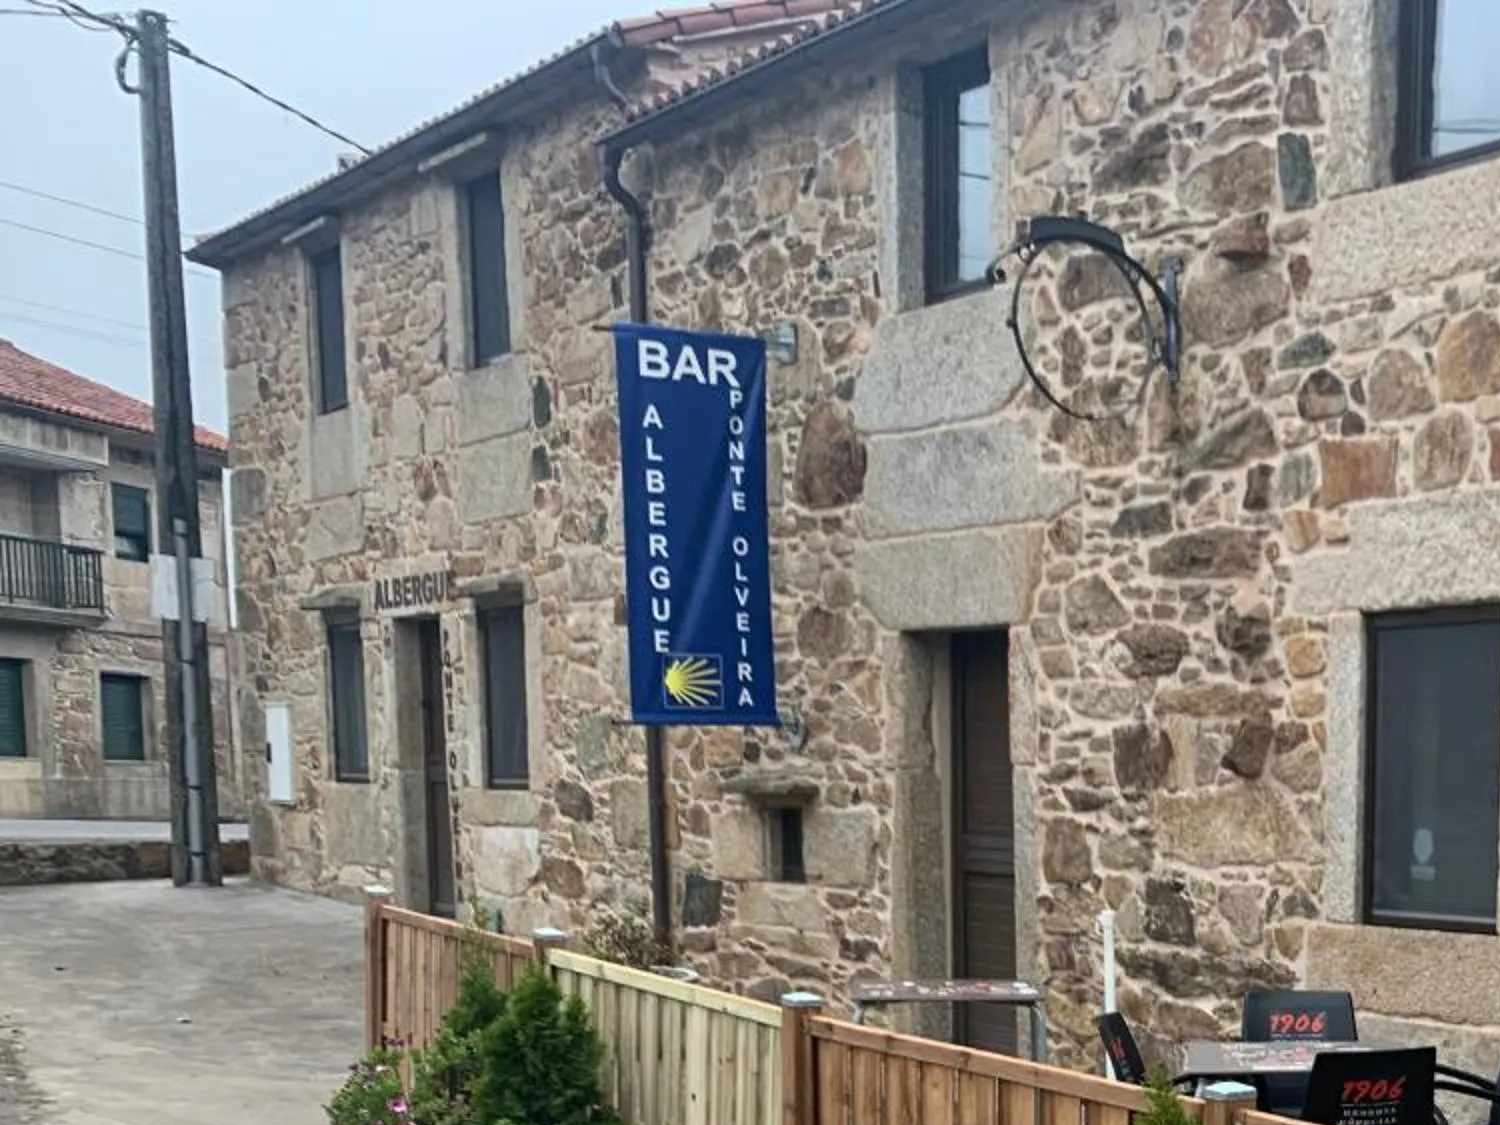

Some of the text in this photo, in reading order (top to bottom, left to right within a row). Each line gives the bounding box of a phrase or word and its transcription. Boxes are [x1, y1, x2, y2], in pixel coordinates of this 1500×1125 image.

[637, 339, 741, 388] BAR
[643, 404, 671, 653] ALBERGUE
[729, 390, 753, 707] PONTE OLVEIRA
[375, 569, 457, 610] ALBERGUE
[1270, 1010, 1326, 1033] 1906
[1341, 1076, 1407, 1103] 1906
